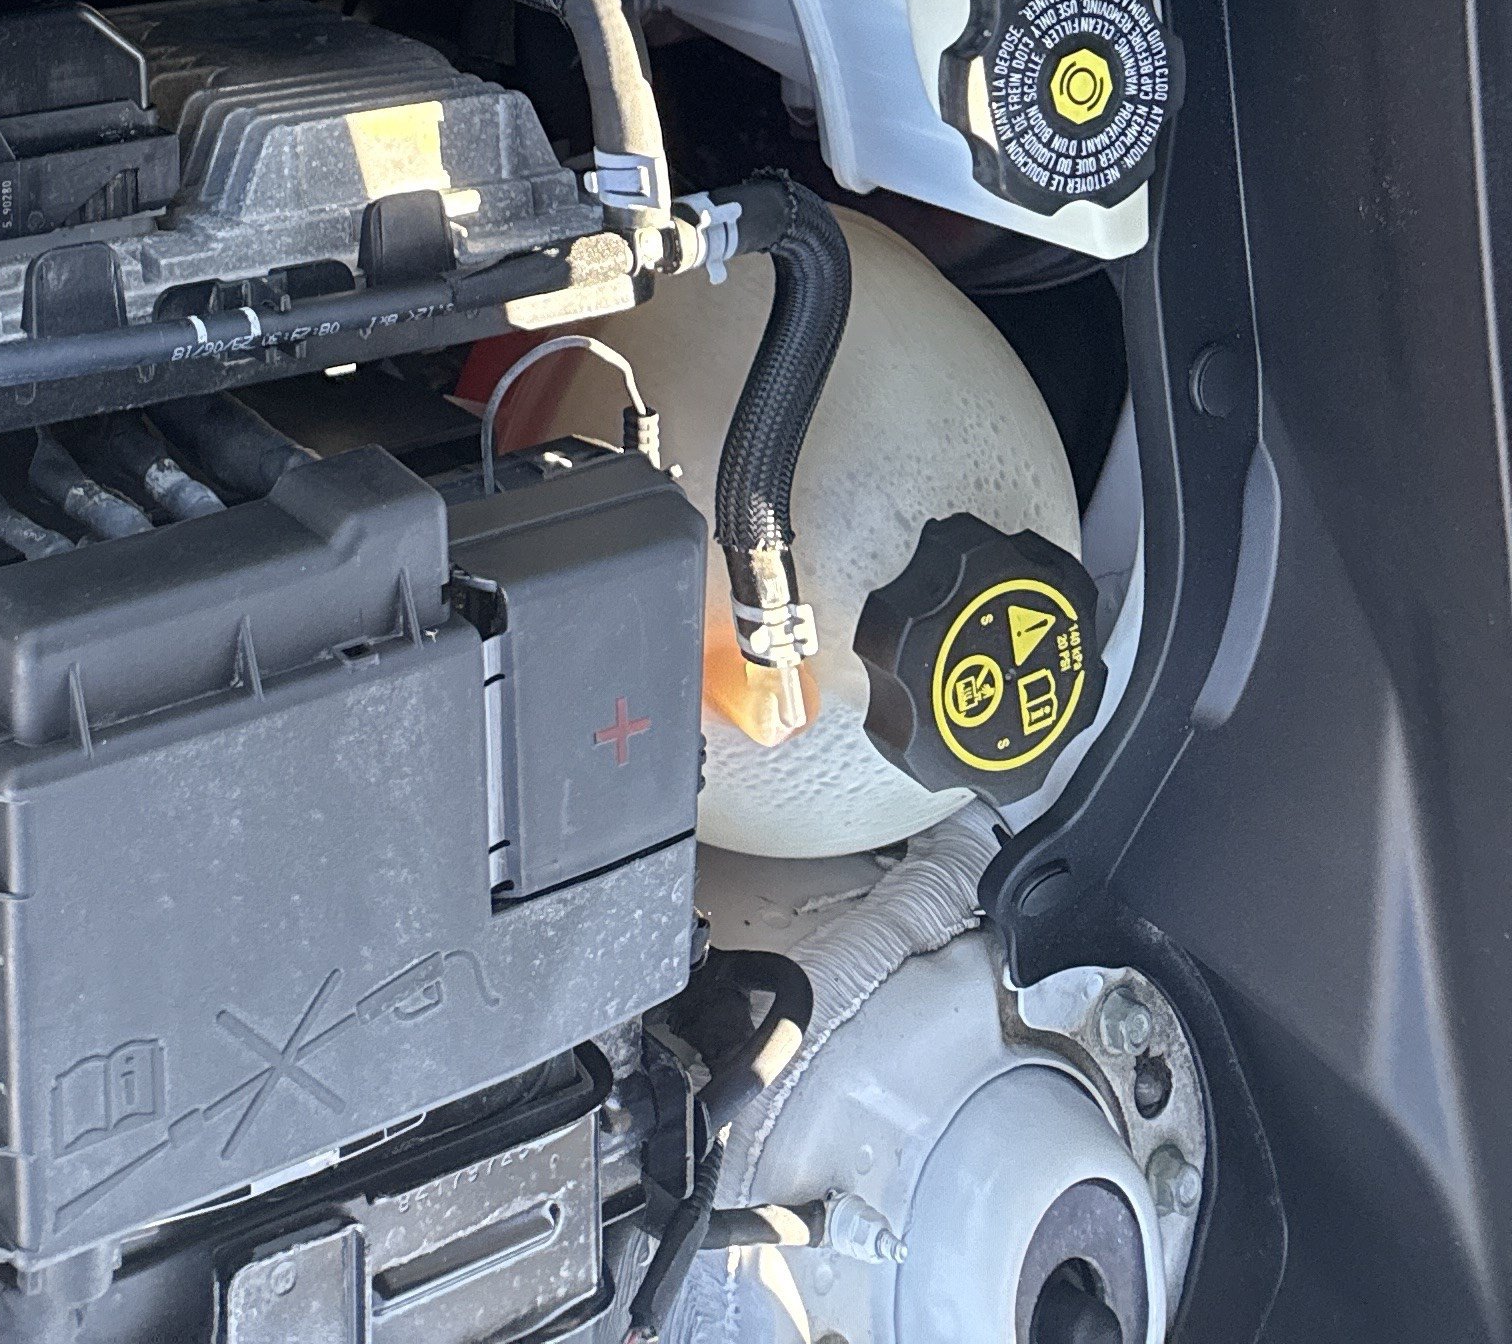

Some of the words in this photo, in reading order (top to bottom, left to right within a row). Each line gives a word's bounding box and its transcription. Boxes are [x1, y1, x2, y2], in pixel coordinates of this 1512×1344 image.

[1031, 10, 1058, 38] ONLY
[1059, 0, 1077, 18] USE
[1127, 0, 1154, 32] FROM
[1042, 18, 1079, 49] FILLER
[1083, 17, 1114, 40] CLEAN
[1012, 36, 1034, 69] DOT3
[1128, 29, 1153, 75] BEFORE
[1147, 33, 1167, 67] FLUID
[992, 78, 1005, 96] LA
[1008, 74, 1022, 111] FREIN
[1141, 74, 1153, 100] CAP
[1155, 68, 1169, 102] DOT3
[991, 101, 1014, 139] AVANT
[1012, 113, 1027, 132] DE
[1028, 105, 1053, 143] BIDON
[1080, 101, 1134, 155] PROVENANT
[1005, 142, 1048, 187] BOUCHON
[1022, 130, 1055, 168] LIQUIDE
[1056, 156, 1073, 174] DU
[1066, 166, 1121, 193] NETTOYER
[1075, 156, 1096, 175] QUE
[1049, 174, 1065, 191] LE
[1057, 633, 1069, 650] 20
